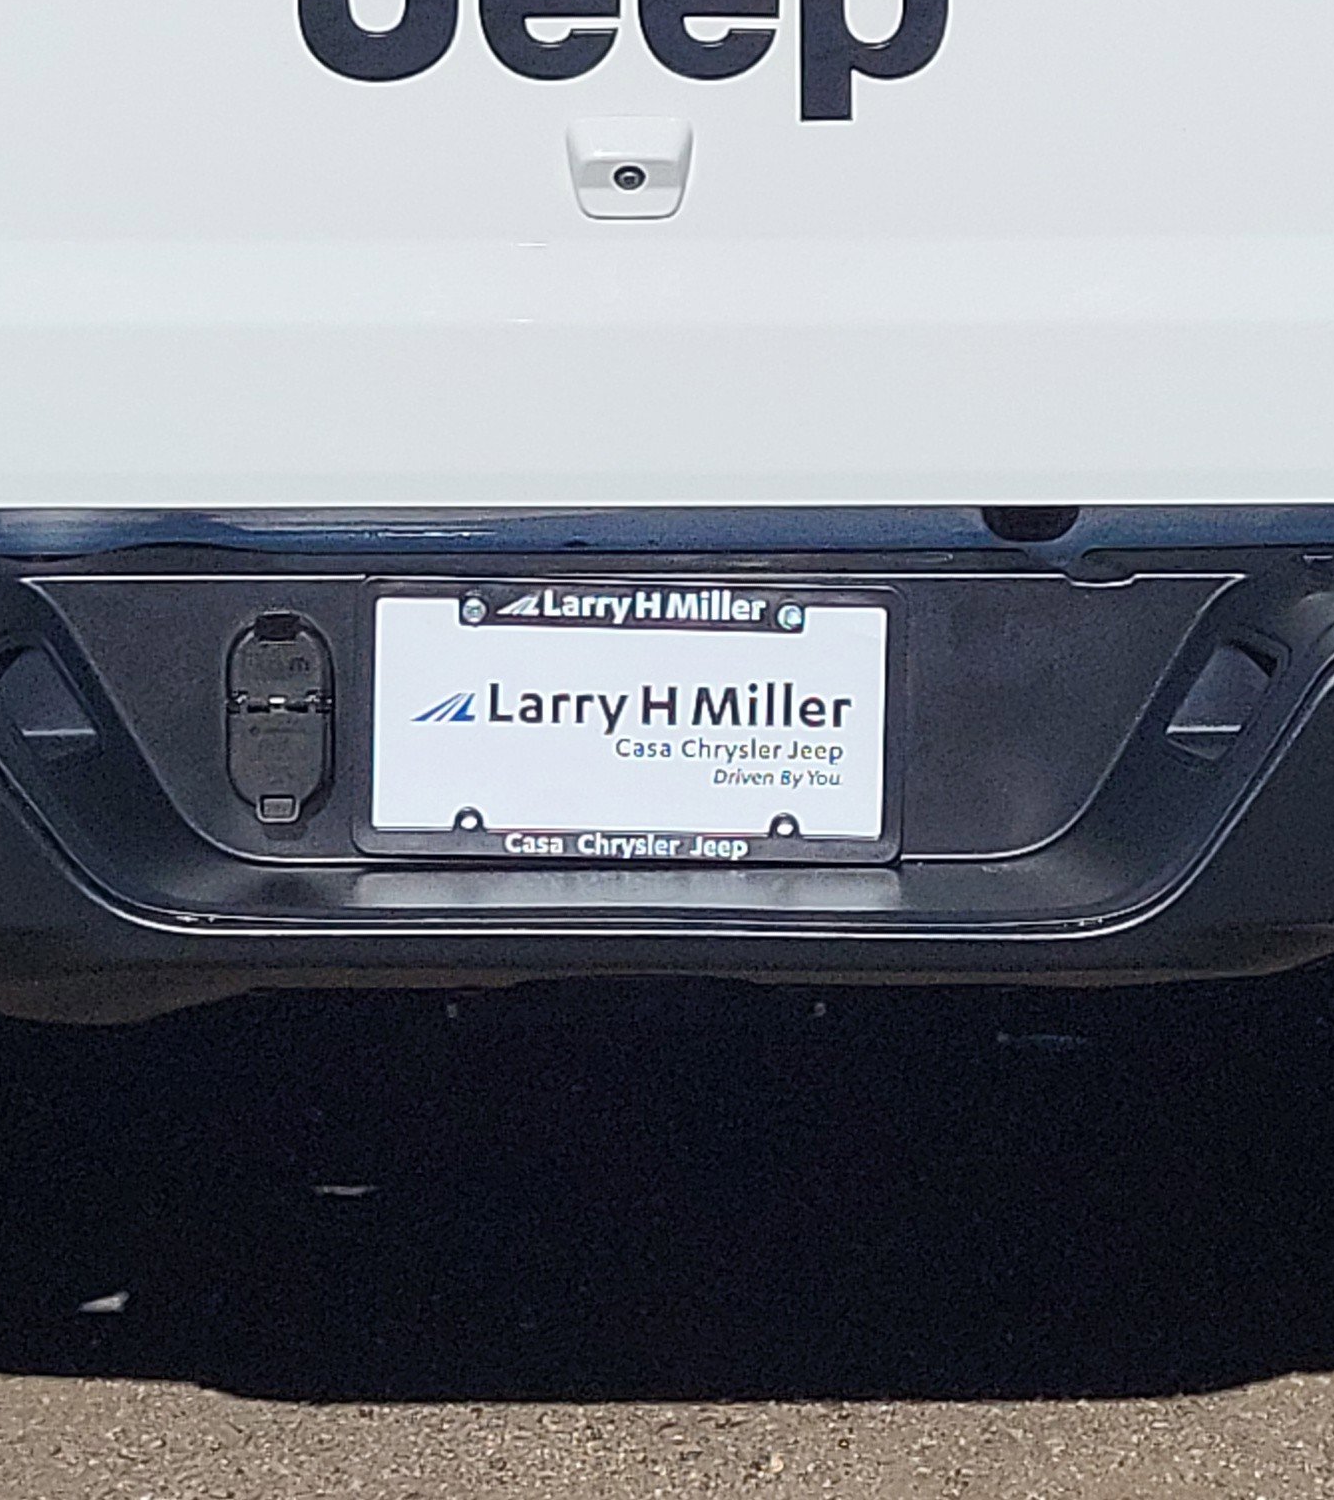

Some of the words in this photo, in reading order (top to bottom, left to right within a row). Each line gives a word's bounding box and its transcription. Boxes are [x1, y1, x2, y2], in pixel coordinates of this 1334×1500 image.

[543, 589, 632, 624] Larry
[635, 591, 661, 619] H
[665, 589, 766, 621] Miller
[488, 682, 629, 736] Larry
[641, 685, 678, 726] H
[691, 681, 852, 729] Miller
[615, 737, 672, 758] Casa
[681, 736, 783, 764] Chrysler
[787, 740, 844, 766] Jeep
[713, 767, 774, 786] Driven
[780, 769, 803, 789] By
[504, 832, 564, 856] Casa
[577, 831, 681, 860] Chrysler
[689, 835, 749, 861] Jeep
